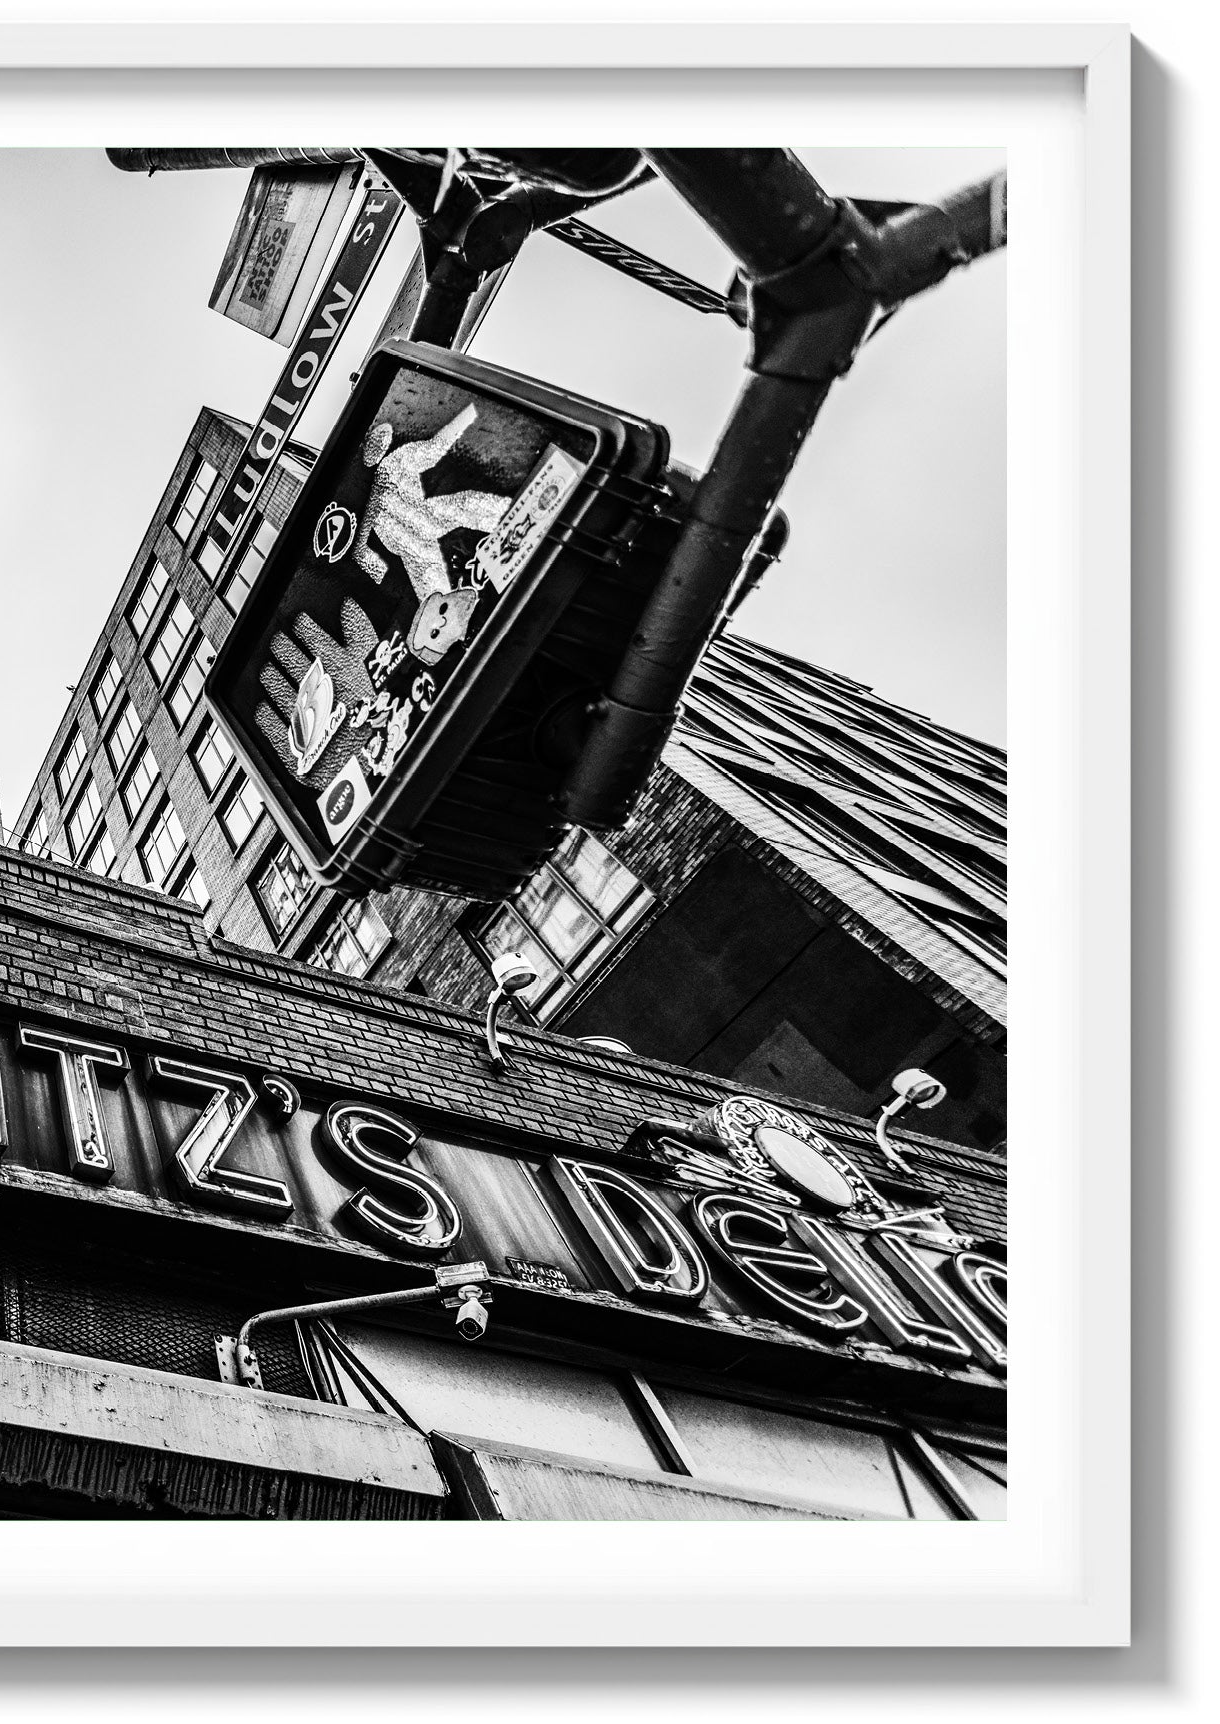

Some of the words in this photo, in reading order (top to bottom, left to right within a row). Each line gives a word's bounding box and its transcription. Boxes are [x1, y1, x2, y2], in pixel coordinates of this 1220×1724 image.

[249, 226, 282, 301] TATTOO
[257, 227, 289, 304] SHOP
[215, 281, 355, 538] Ludlow
[352, 197, 388, 247] St
